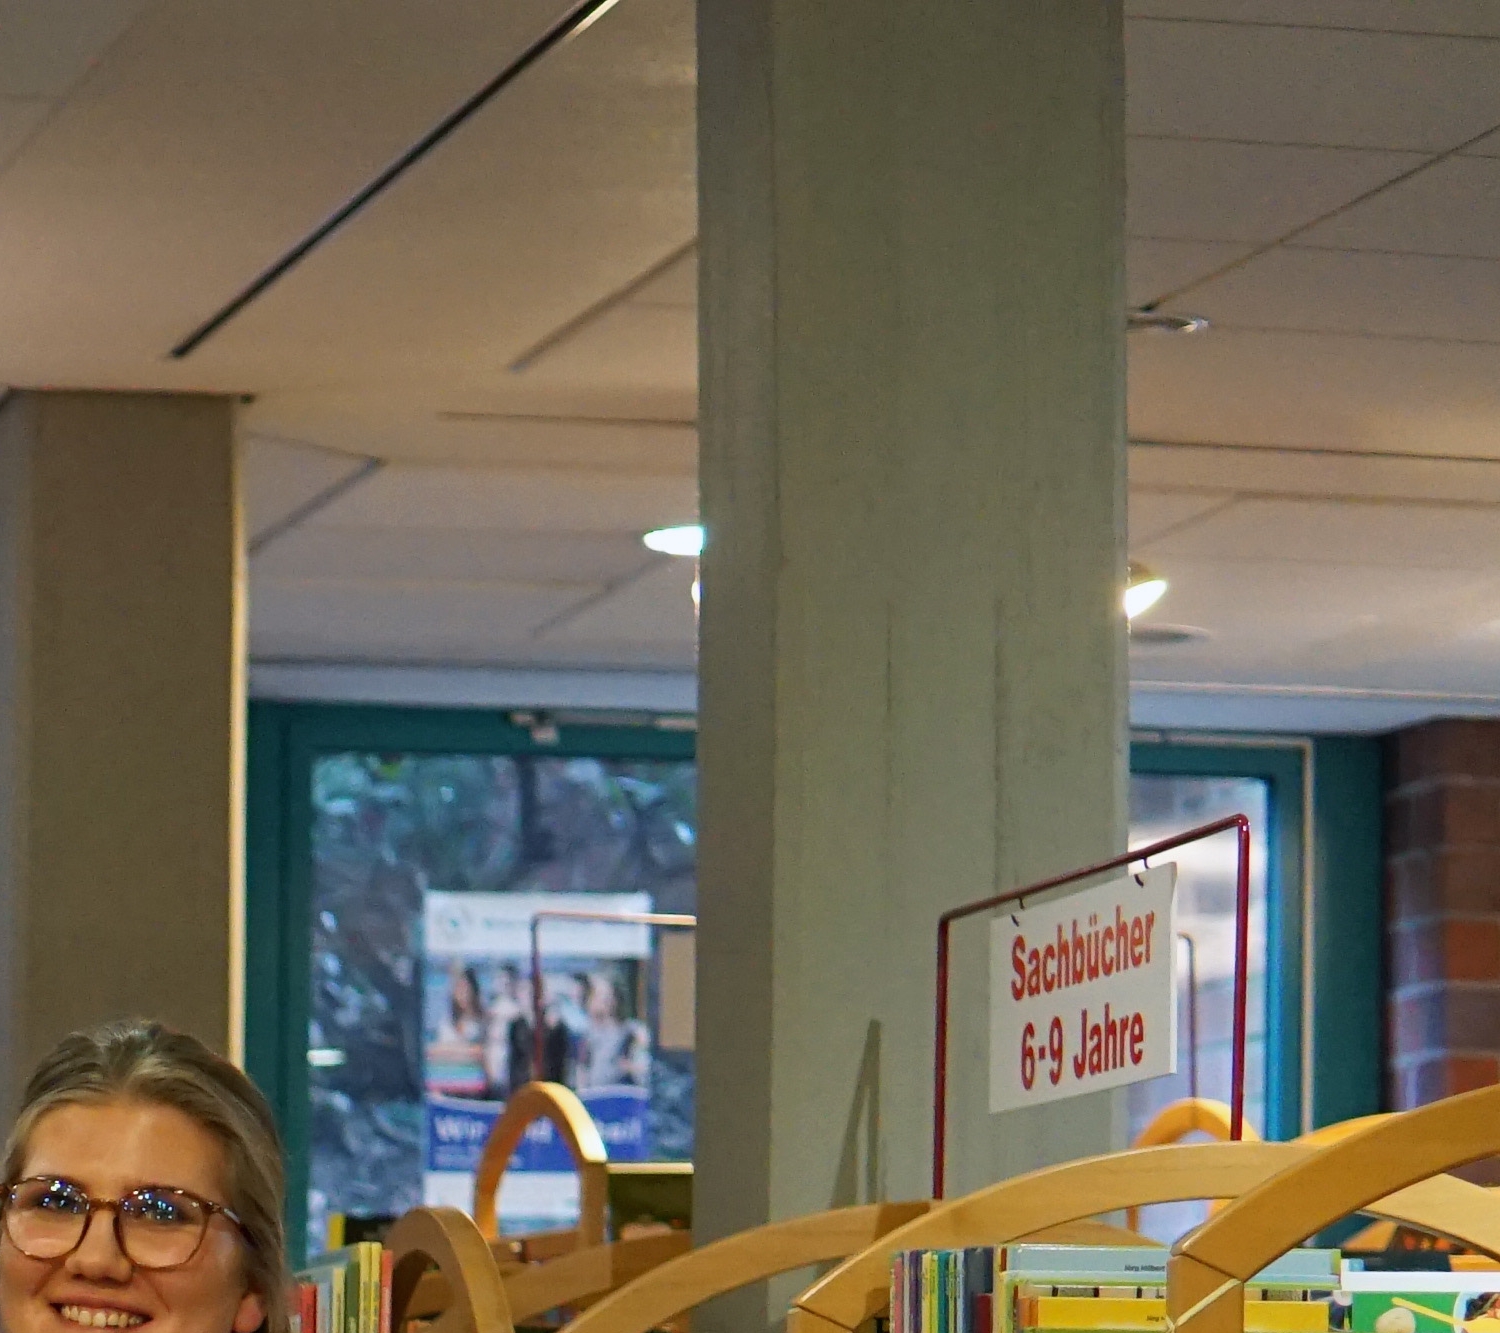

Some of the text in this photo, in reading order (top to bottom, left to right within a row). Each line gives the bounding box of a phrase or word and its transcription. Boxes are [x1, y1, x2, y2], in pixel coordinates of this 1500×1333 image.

[1010, 904, 1155, 1002] Sachbücher
[1021, 1002, 1144, 1092] 6-9 Jahre
